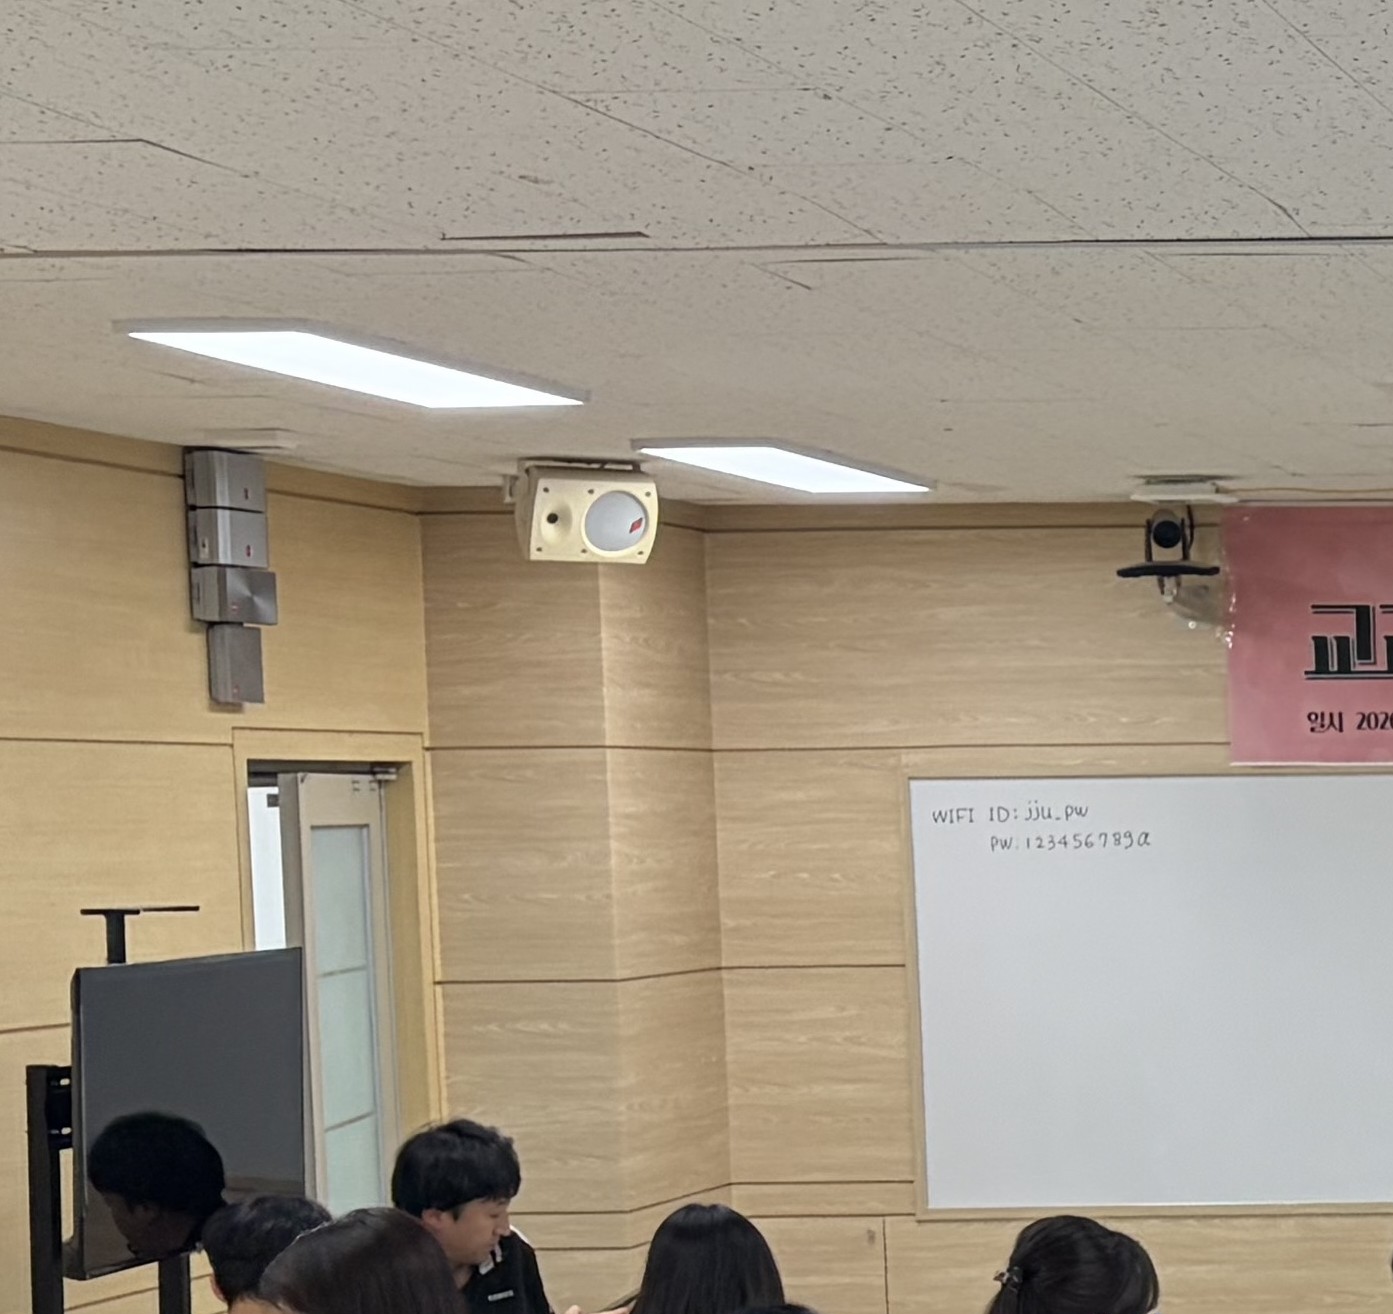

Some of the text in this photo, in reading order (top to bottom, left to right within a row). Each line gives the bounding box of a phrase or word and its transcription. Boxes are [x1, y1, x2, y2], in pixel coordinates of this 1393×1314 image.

[1307, 712, 1343, 732] 일시
[932, 808, 975, 824] WIFI
[989, 806, 1018, 823] ID:
